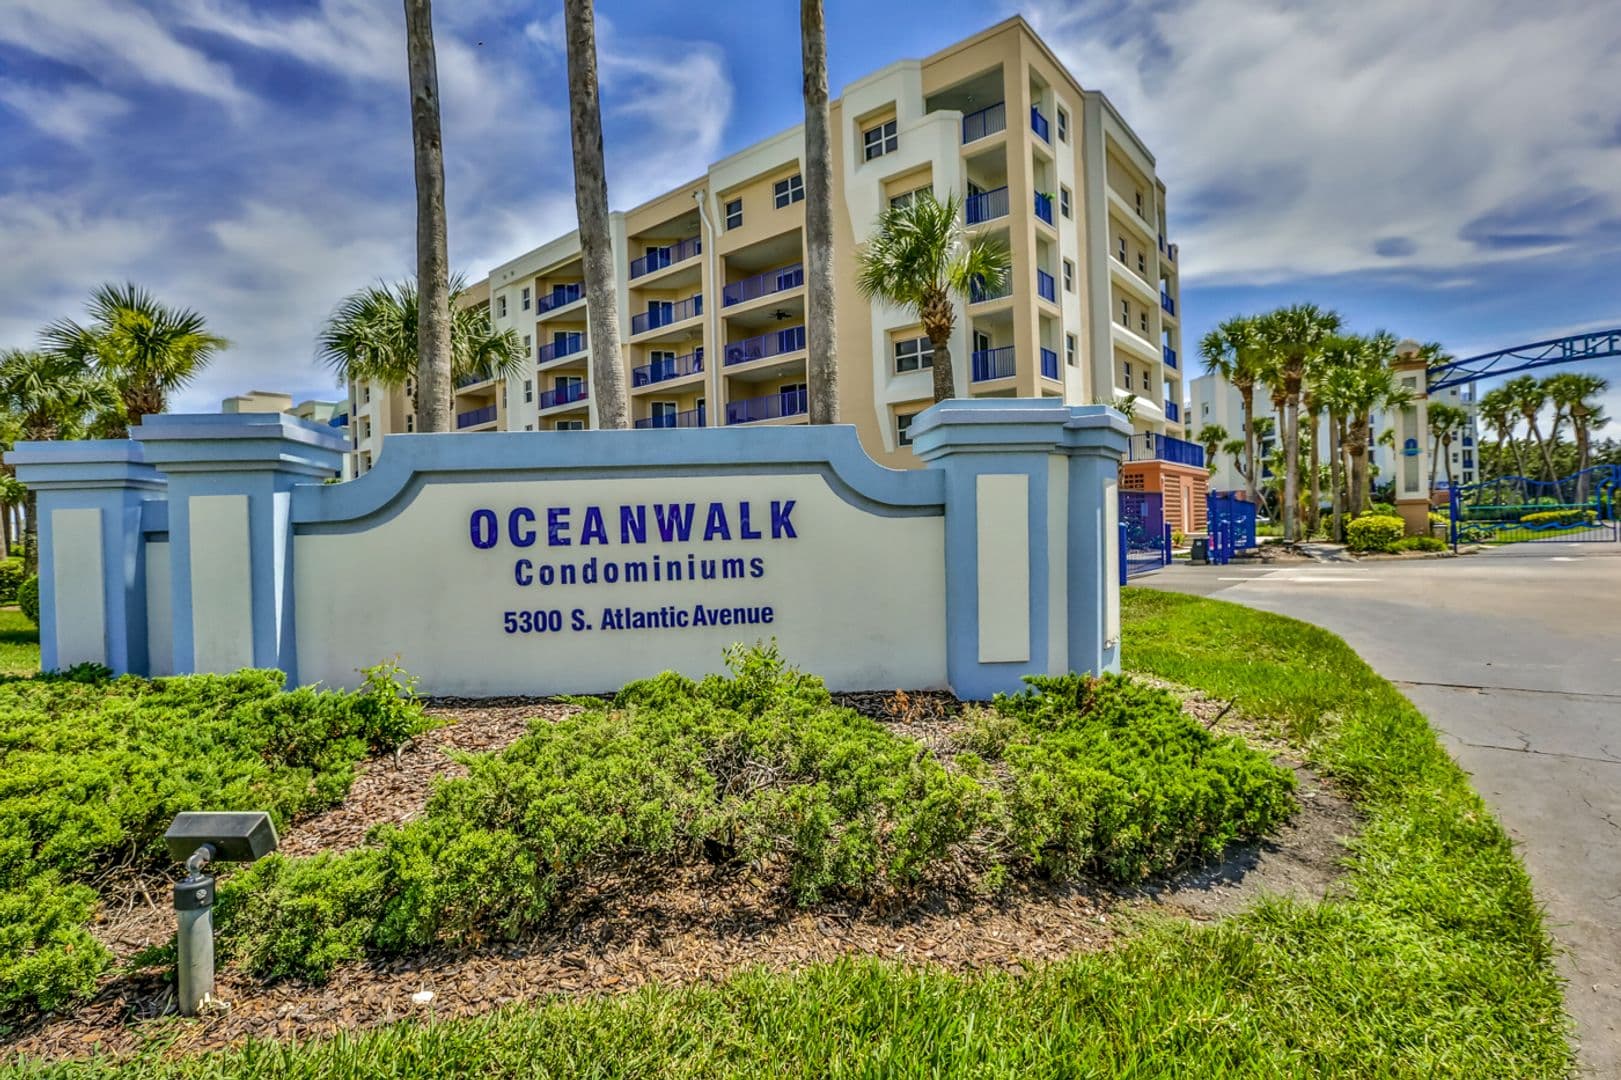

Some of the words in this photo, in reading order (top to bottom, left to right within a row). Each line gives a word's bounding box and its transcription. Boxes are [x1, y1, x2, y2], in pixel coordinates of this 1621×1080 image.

[469, 500, 798, 550] OCEANWALK
[514, 553, 765, 587] Condominiums
[503, 608, 562, 634] 5300
[570, 608, 593, 632] S.
[600, 605, 689, 631] Atlantic
[692, 604, 774, 627] Avenue
